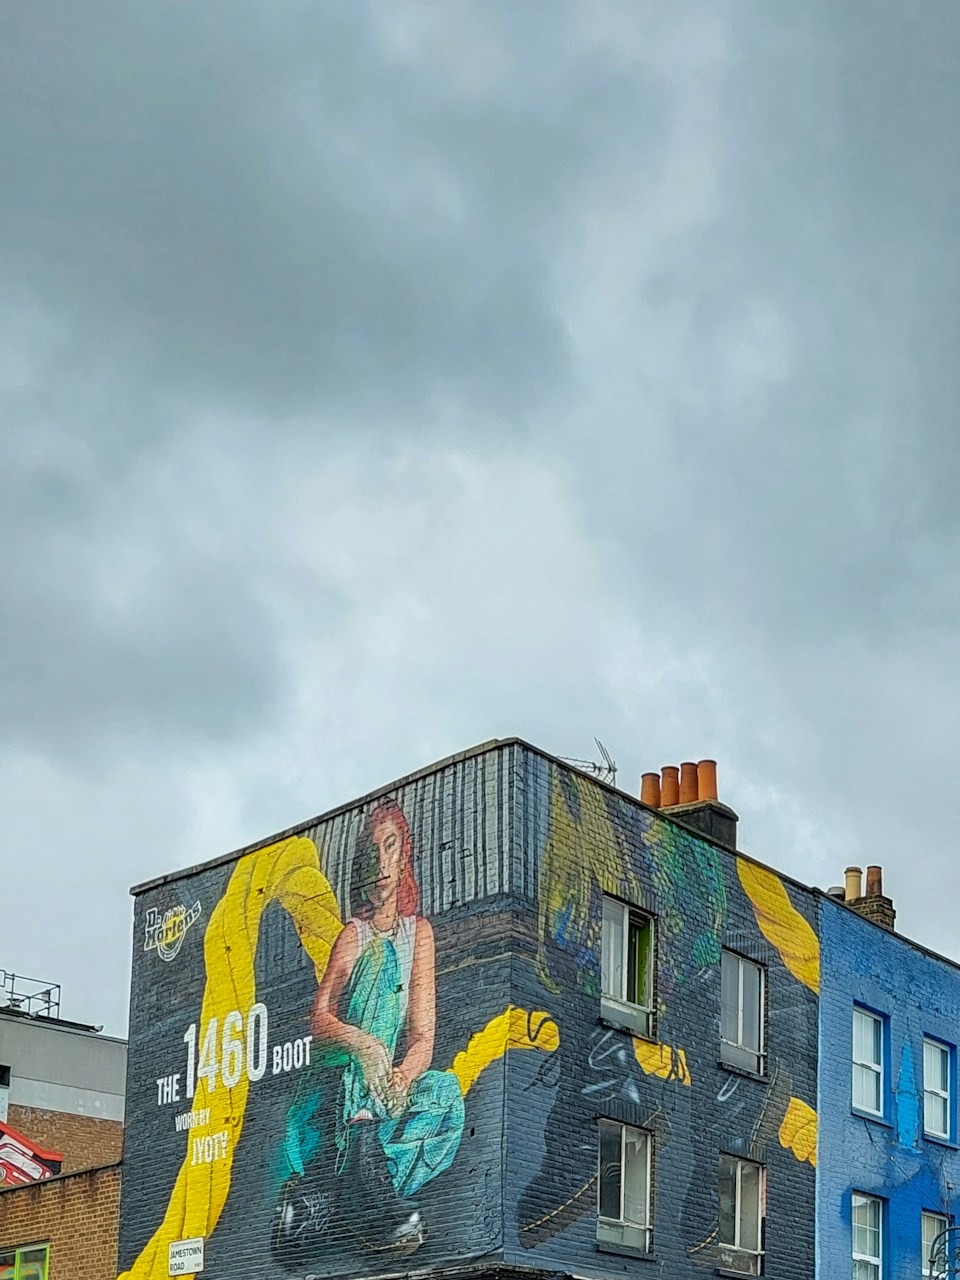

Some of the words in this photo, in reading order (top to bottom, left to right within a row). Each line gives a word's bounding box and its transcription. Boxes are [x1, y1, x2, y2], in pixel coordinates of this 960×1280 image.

[156, 1074, 181, 1106] THE
[183, 1002, 269, 1100] 1460
[272, 1035, 313, 1076] BOOT
[174, 1111, 199, 1132] WORN
[190, 1129, 229, 1167] JYOTY
[169, 1246, 202, 1260] JAMESTOWN
[169, 1261, 185, 1272] ROAD
